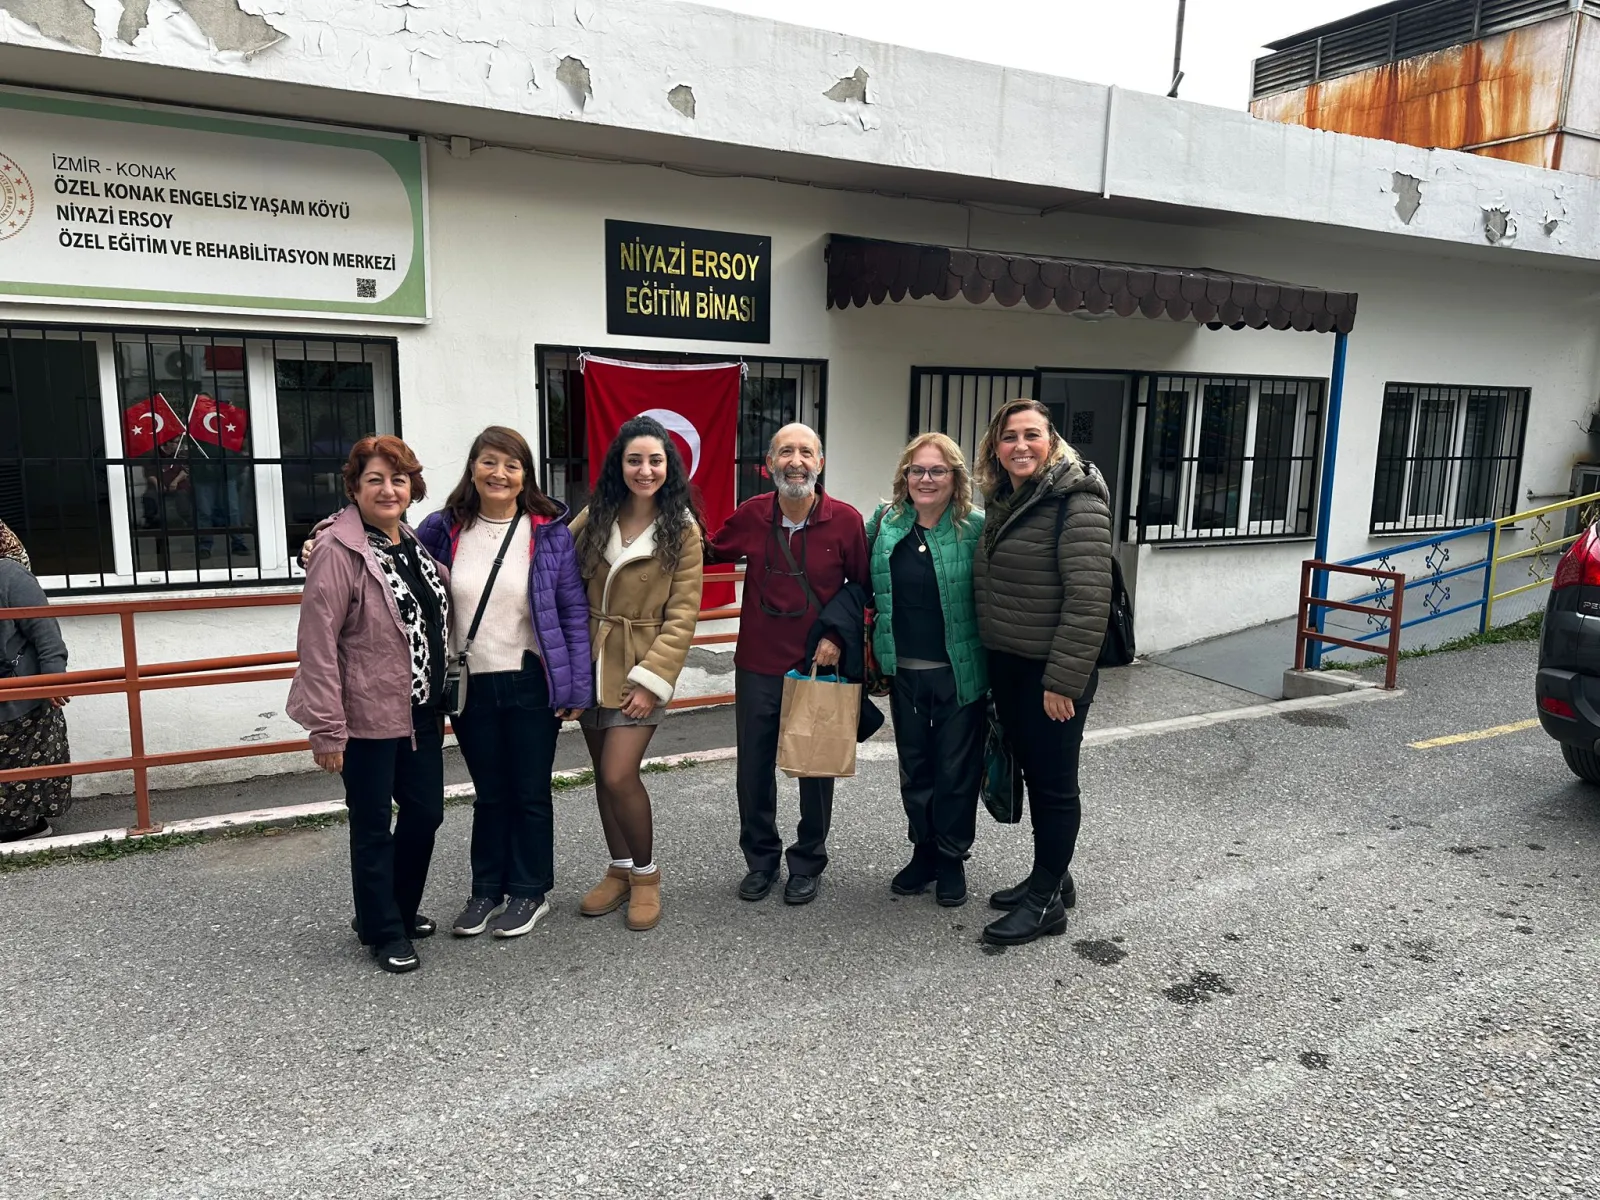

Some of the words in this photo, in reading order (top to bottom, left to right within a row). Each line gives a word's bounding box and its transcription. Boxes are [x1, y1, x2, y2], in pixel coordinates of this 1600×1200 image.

[52, 153, 101, 174] İZMİR
[116, 162, 177, 181] KONAK
[54, 174, 101, 197] ÖZEL
[104, 182, 166, 203] KONAK
[169, 188, 248, 210] ENGELSİZ
[249, 196, 305, 217] YAŞAM
[308, 200, 350, 219] KÖYÜ
[56, 202, 115, 224] NİYAZİ
[118, 210, 173, 229] ERSOY
[59, 227, 105, 250] ÖZEL
[108, 232, 168, 255] EĞİTİM
[170, 239, 192, 256] VE
[195, 241, 329, 266] REHABİLİTASYON
[332, 252, 396, 271] MERKEZİ
[620, 236, 686, 276] NİYAZİ
[692, 249, 760, 282] ERSOY
[626, 280, 690, 318] EĞİTİM
[696, 286, 756, 322] BİNASI
[1583, 601, 1600, 610] PE
